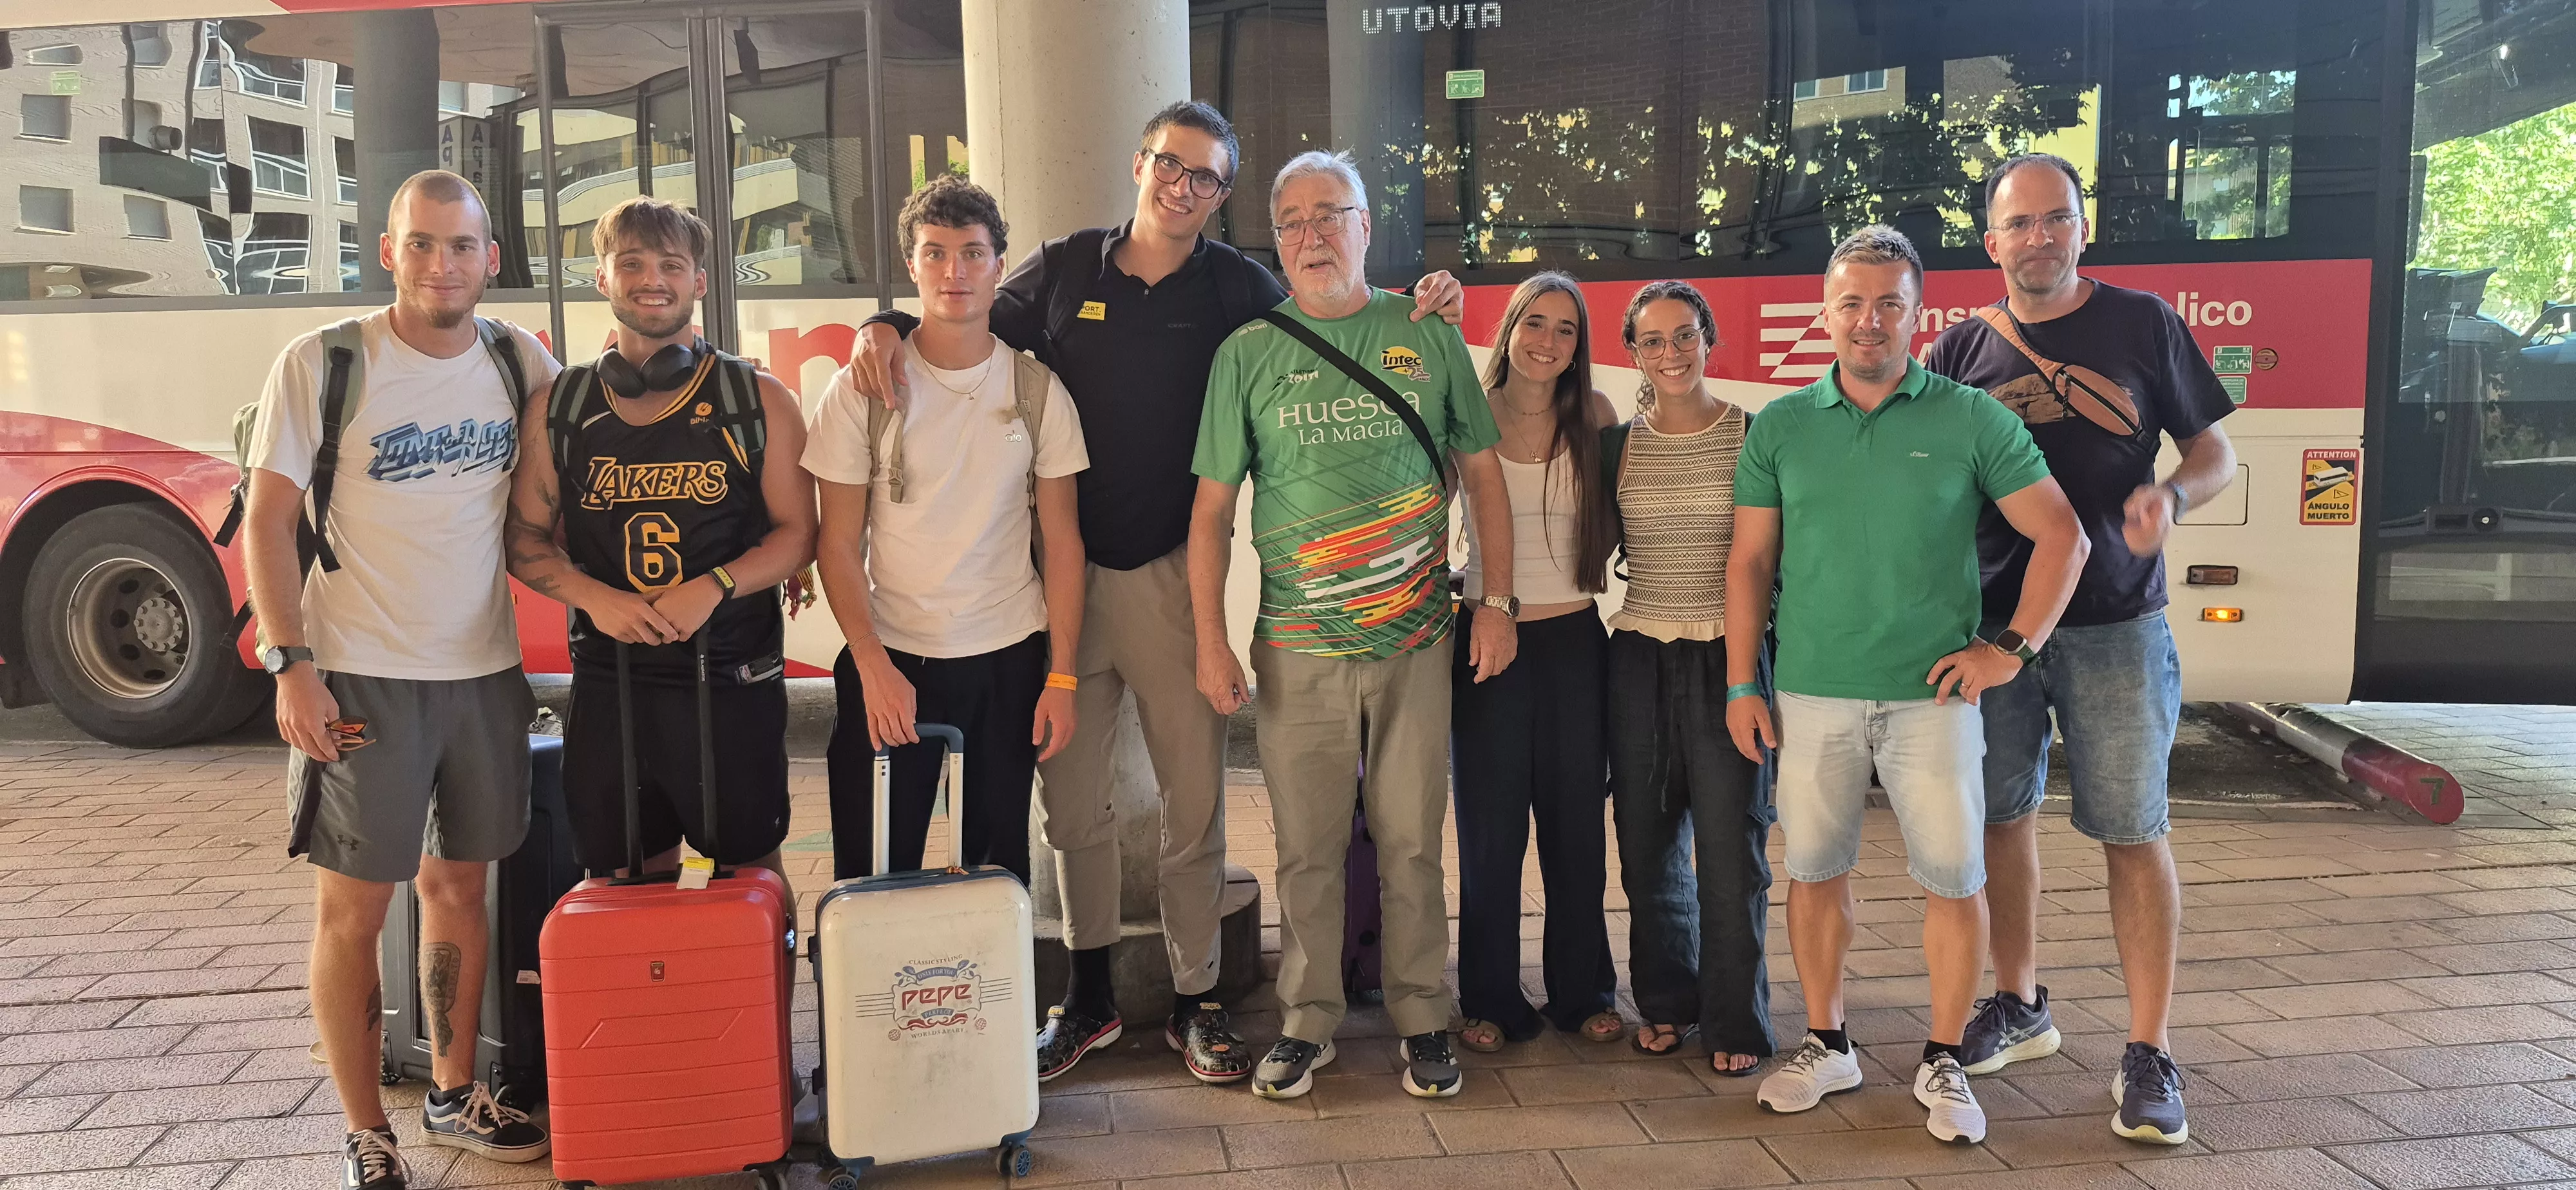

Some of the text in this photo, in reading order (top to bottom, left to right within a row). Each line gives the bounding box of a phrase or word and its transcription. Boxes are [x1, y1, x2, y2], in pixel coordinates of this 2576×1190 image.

[1362, 2, 1502, 34] UTOVIA
[2168, 291, 2253, 327] lico
[1381, 350, 1422, 366] intec
[581, 456, 728, 511] LAKERS
[2307, 501, 2350, 510] ÁNGULO
[624, 512, 684, 594] 6
[2420, 777, 2445, 805] 7
[936, 954, 963, 965] STYLING
[918, 970, 931, 979] ONLY
[924, 1008, 952, 1018] PERFECT
[911, 1029, 940, 1039] WORLDS
